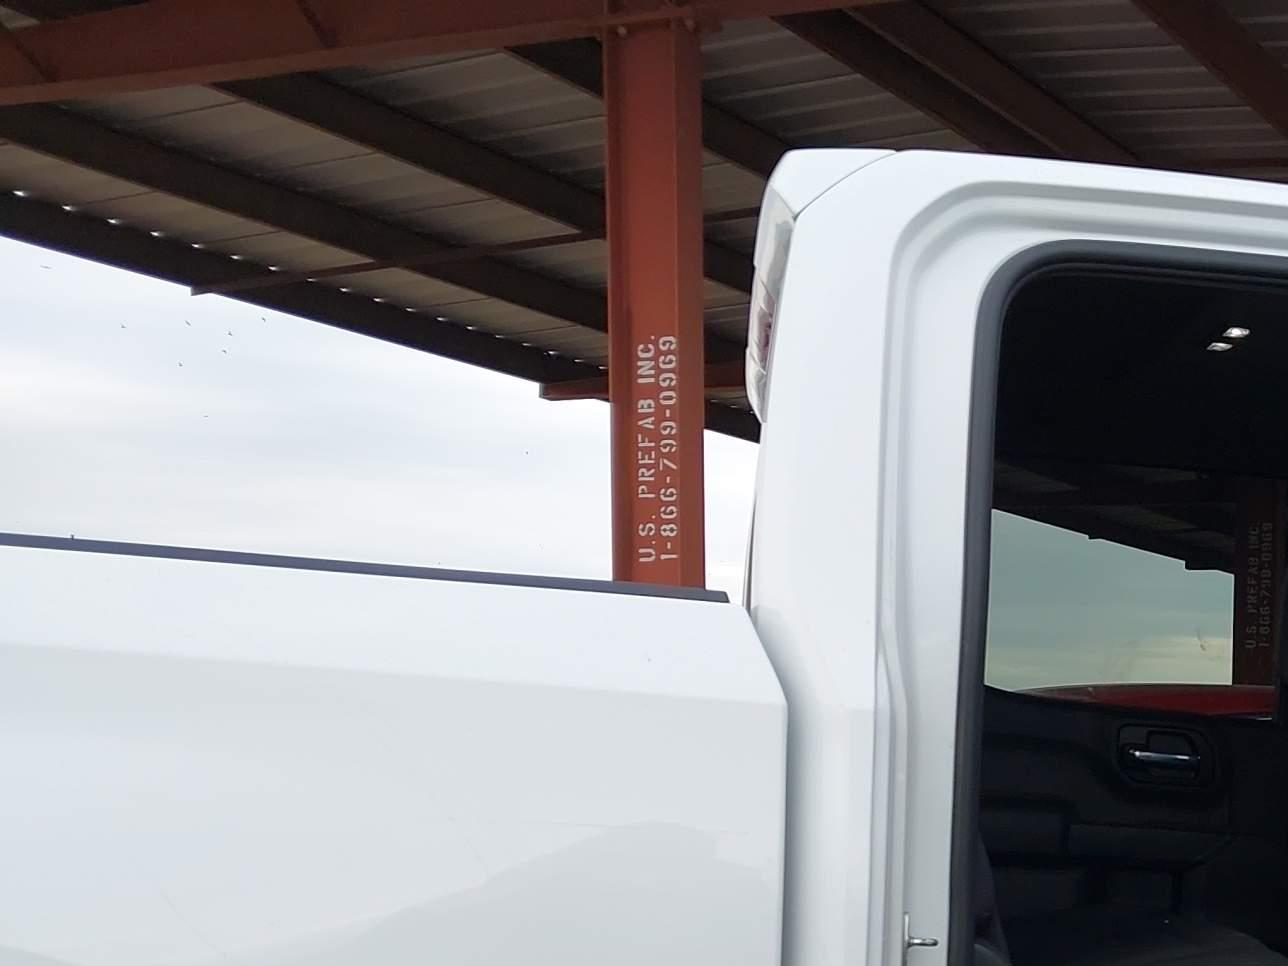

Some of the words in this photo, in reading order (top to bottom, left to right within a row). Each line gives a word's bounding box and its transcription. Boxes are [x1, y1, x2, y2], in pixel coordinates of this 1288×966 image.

[637, 335, 656, 384] INC.
[638, 398, 656, 499] PREFAB
[658, 335, 679, 561] 1-866-799-0969
[638, 515, 656, 562] U.S.
